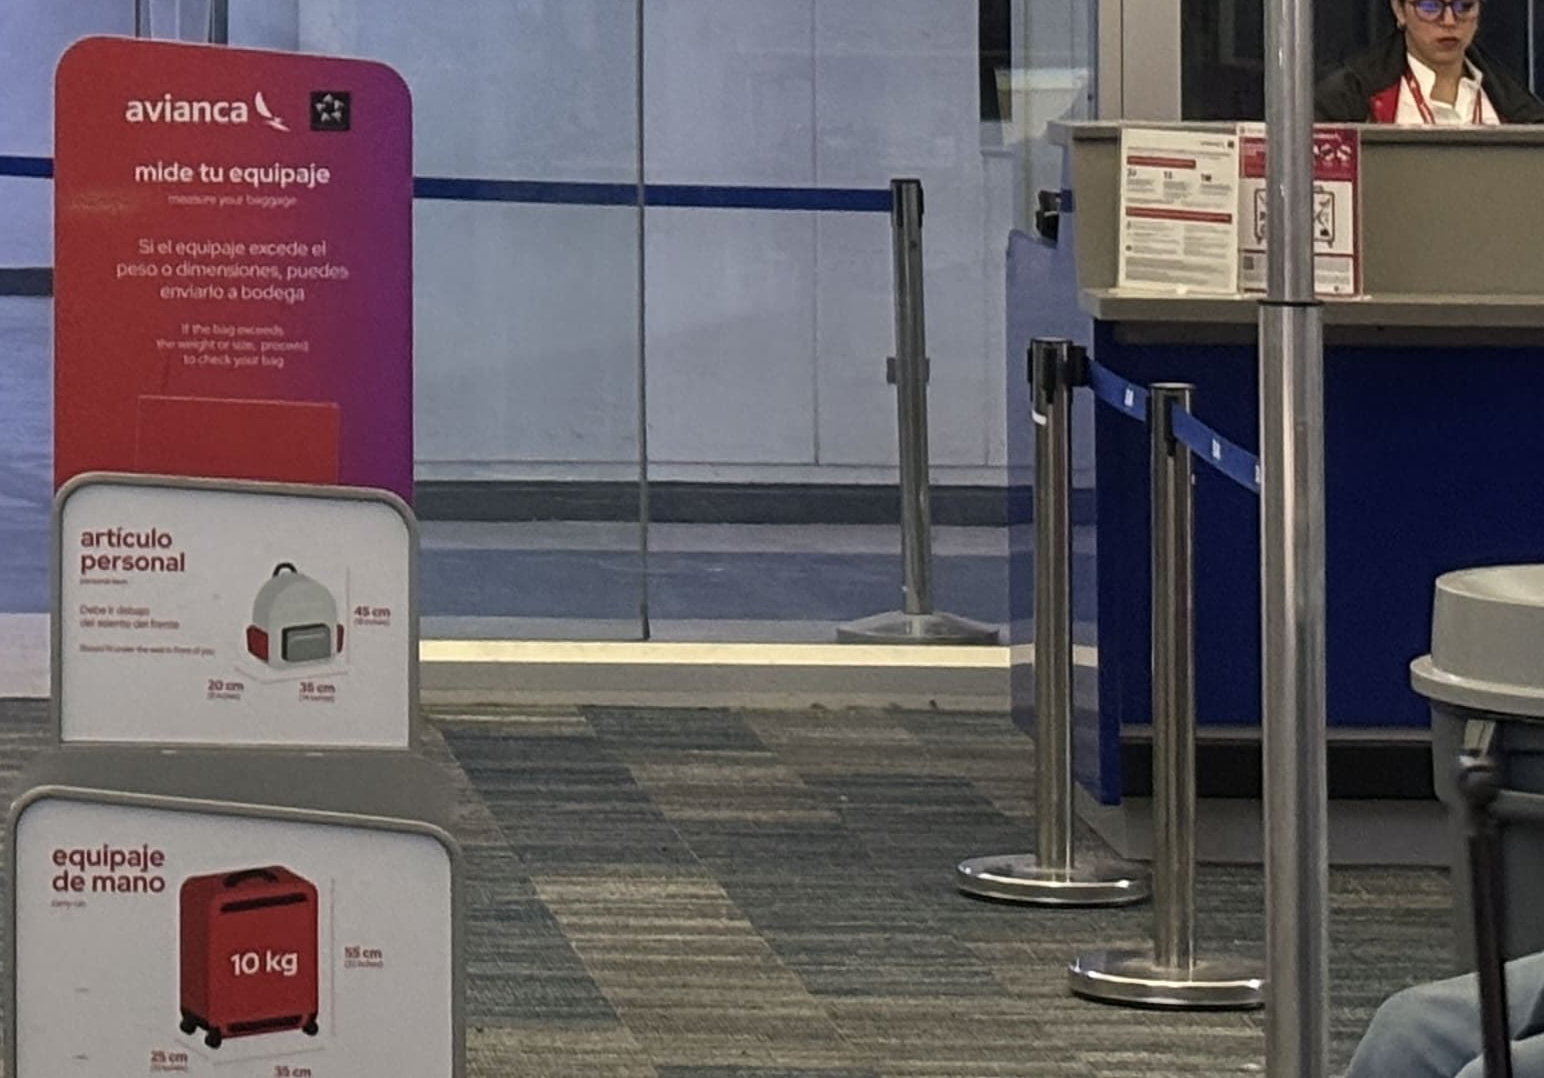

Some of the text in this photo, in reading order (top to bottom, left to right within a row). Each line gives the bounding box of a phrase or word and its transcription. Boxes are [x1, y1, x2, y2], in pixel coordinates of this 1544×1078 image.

[126, 93, 248, 124] avianca
[134, 161, 331, 188] mide tu equipaje
[138, 238, 327, 258] Si el equipaje excede el
[116, 261, 349, 280] peso o dimensiones, puedes
[160, 284, 305, 304] enviarlo a bodega
[80, 526, 172, 549] artículo
[80, 552, 185, 575] personal
[354, 606, 391, 617] 45 cm
[208, 680, 244, 692] 20 cm
[316, 684, 335, 694] cm
[52, 844, 165, 872] equipaje
[52, 870, 166, 893] de mano
[230, 949, 298, 976] 10 kg
[363, 948, 383, 959] cm
[168, 1052, 188, 1063] cm
[292, 1067, 311, 1078] cm
